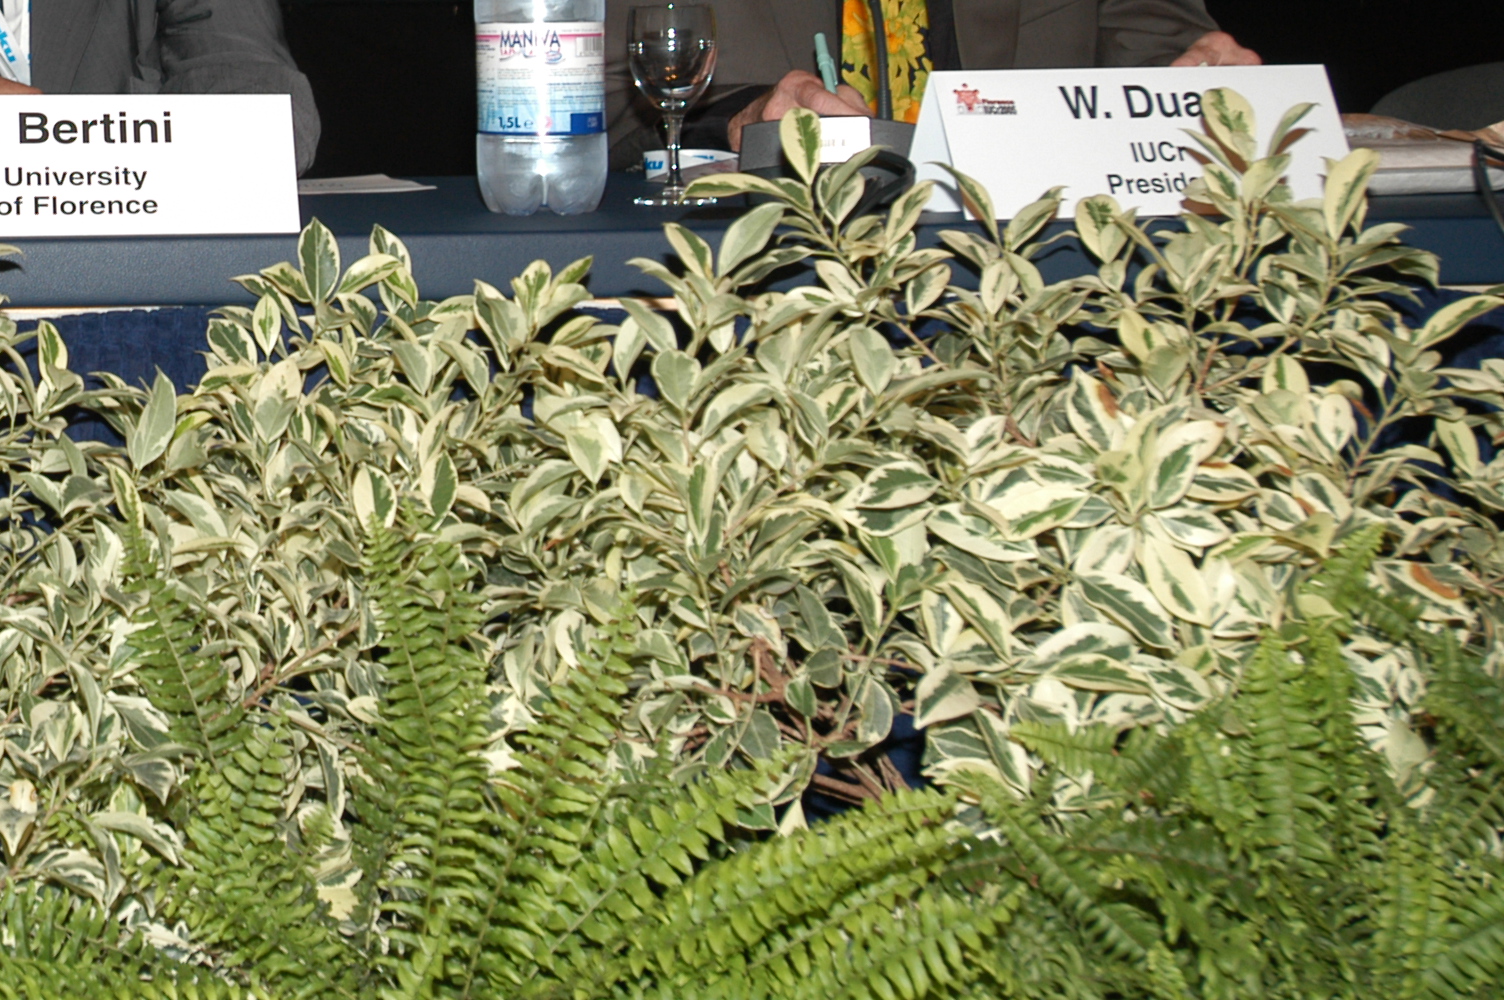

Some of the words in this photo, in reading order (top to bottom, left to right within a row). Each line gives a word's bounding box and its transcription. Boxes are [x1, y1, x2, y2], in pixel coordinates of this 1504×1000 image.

[1059, 84, 1112, 119] W.
[1122, 85, 1206, 118] Dua
[18, 110, 173, 144] Bertini
[4, 166, 147, 191] University
[1107, 172, 1197, 196] Presid
[34, 195, 159, 216] Florence
